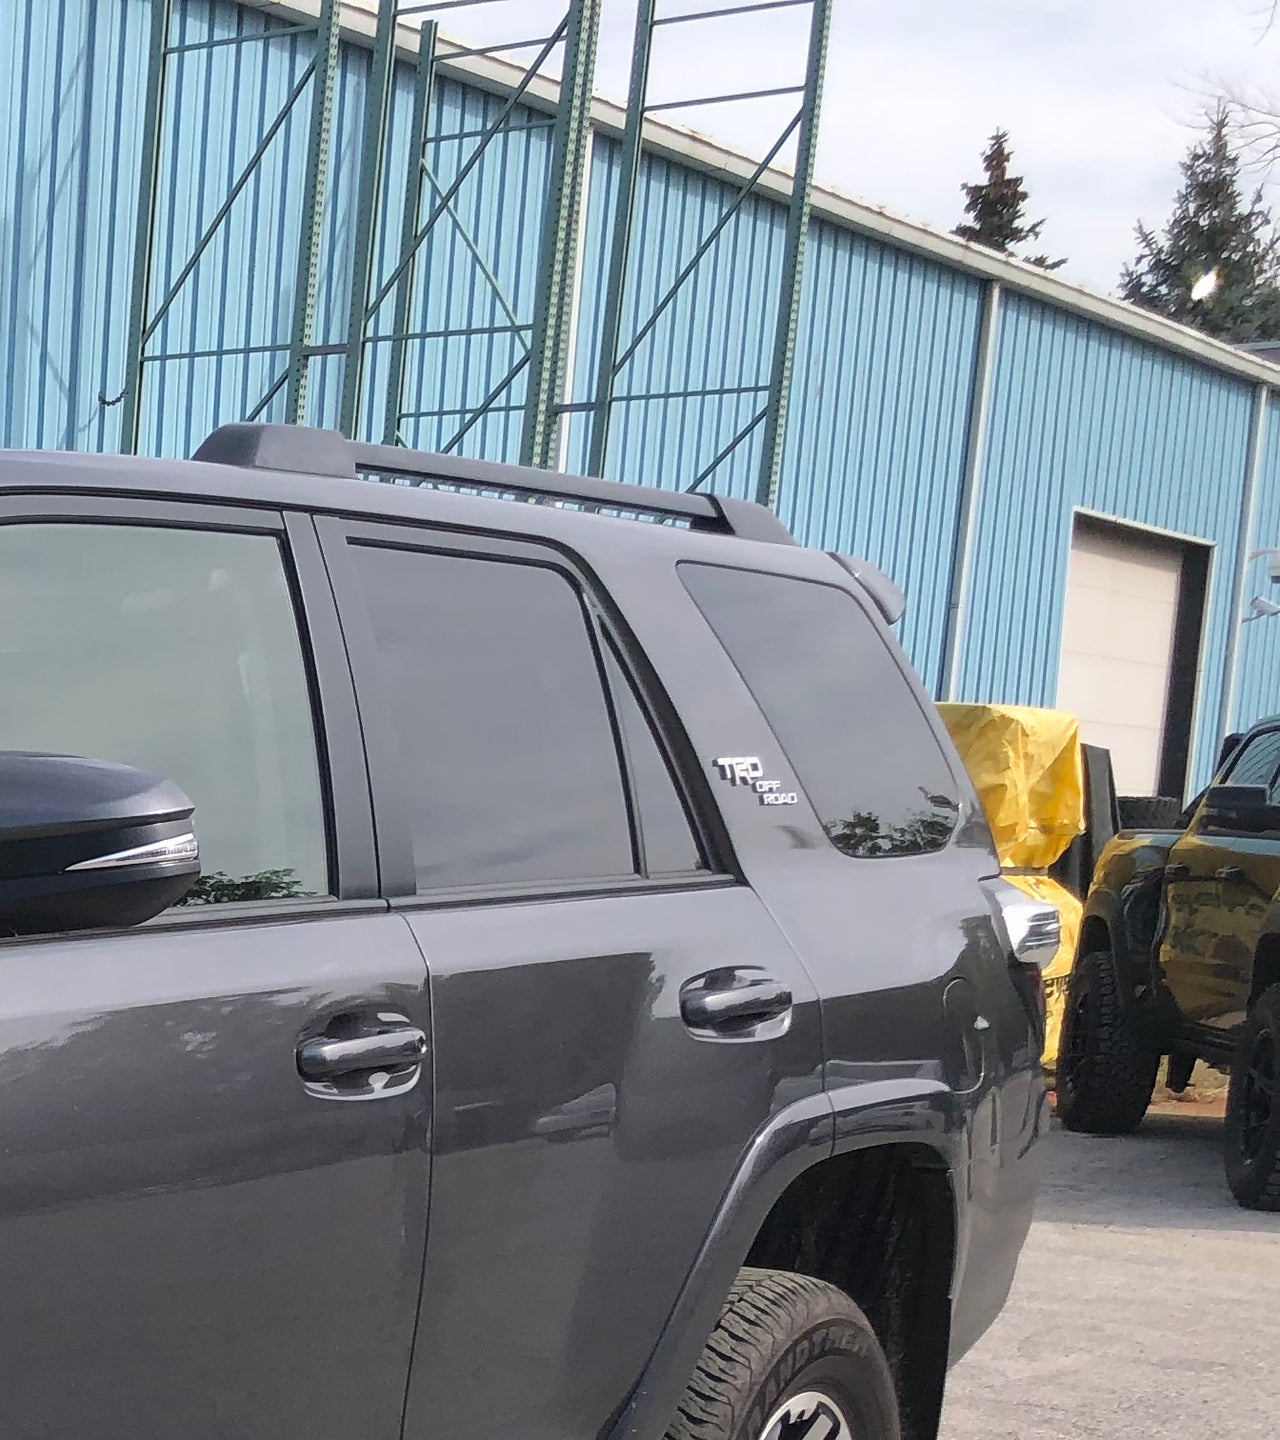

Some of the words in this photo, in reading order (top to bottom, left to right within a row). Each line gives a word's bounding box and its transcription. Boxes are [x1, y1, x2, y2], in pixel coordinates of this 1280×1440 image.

[714, 756, 764, 786] TRD
[755, 780, 782, 792] OFF
[761, 792, 799, 805] ROAD
